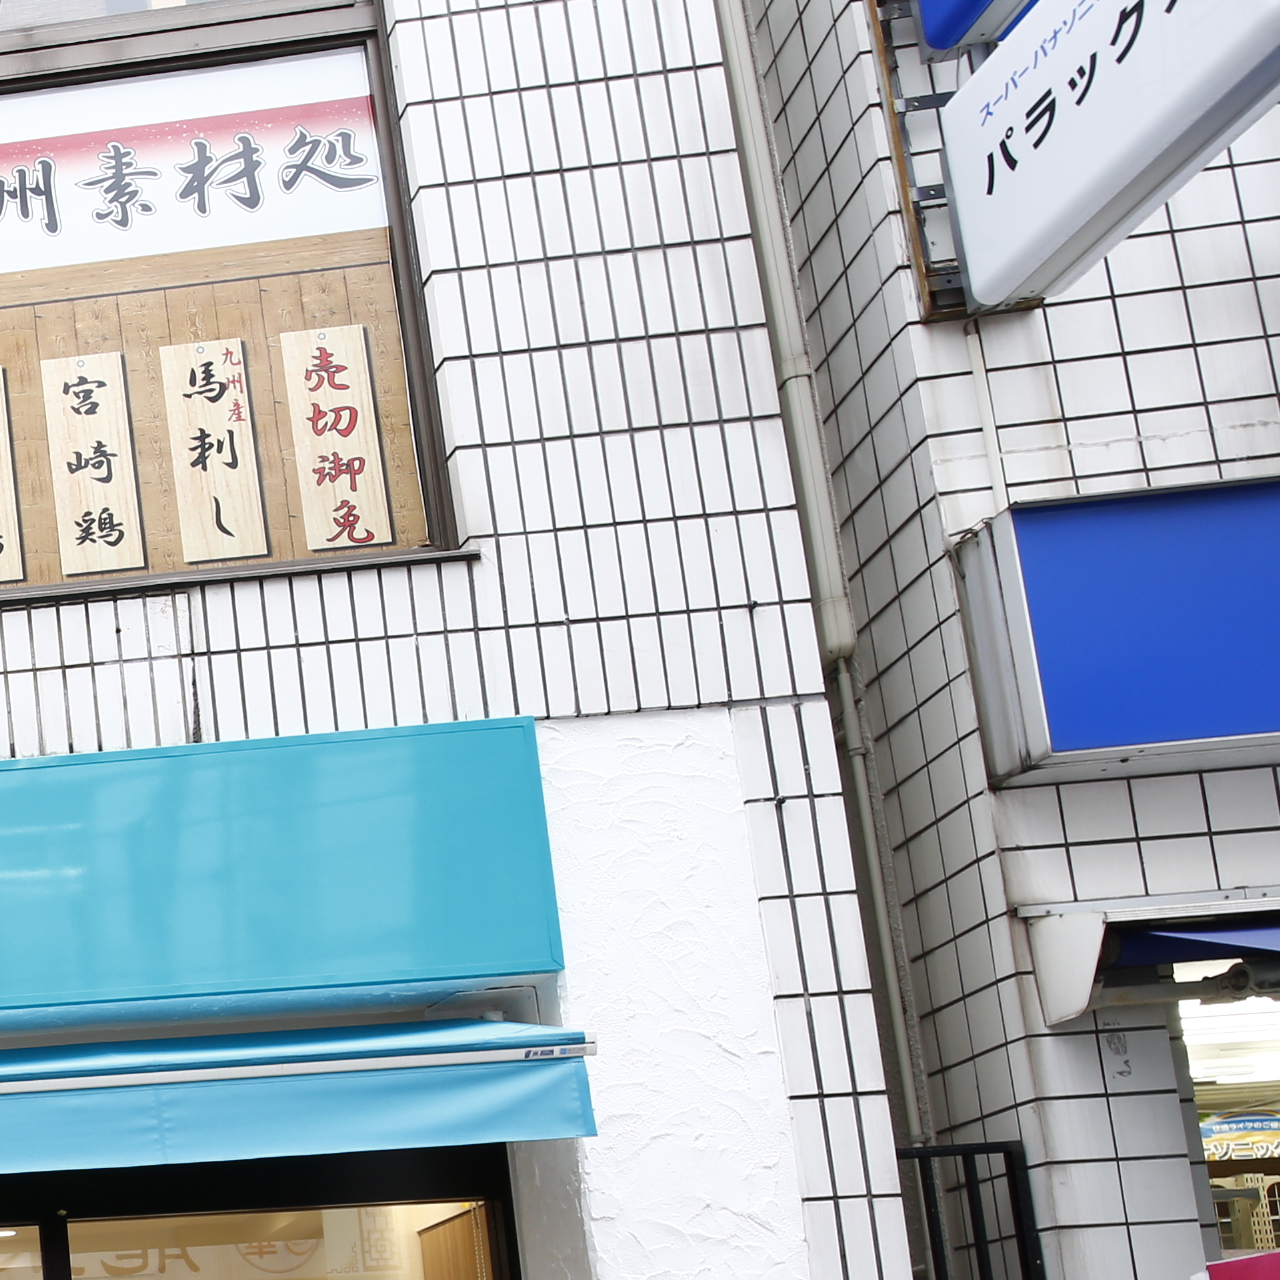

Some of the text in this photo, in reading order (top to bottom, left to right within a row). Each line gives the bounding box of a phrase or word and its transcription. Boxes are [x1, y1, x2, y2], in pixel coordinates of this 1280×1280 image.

[986, 0, 1178, 196] パラック
[62, 375, 125, 549] 宮崎鶏
[182, 361, 239, 538] 馬刺し
[221, 348, 247, 424] 九州産
[304, 346, 376, 544] 売切御免
